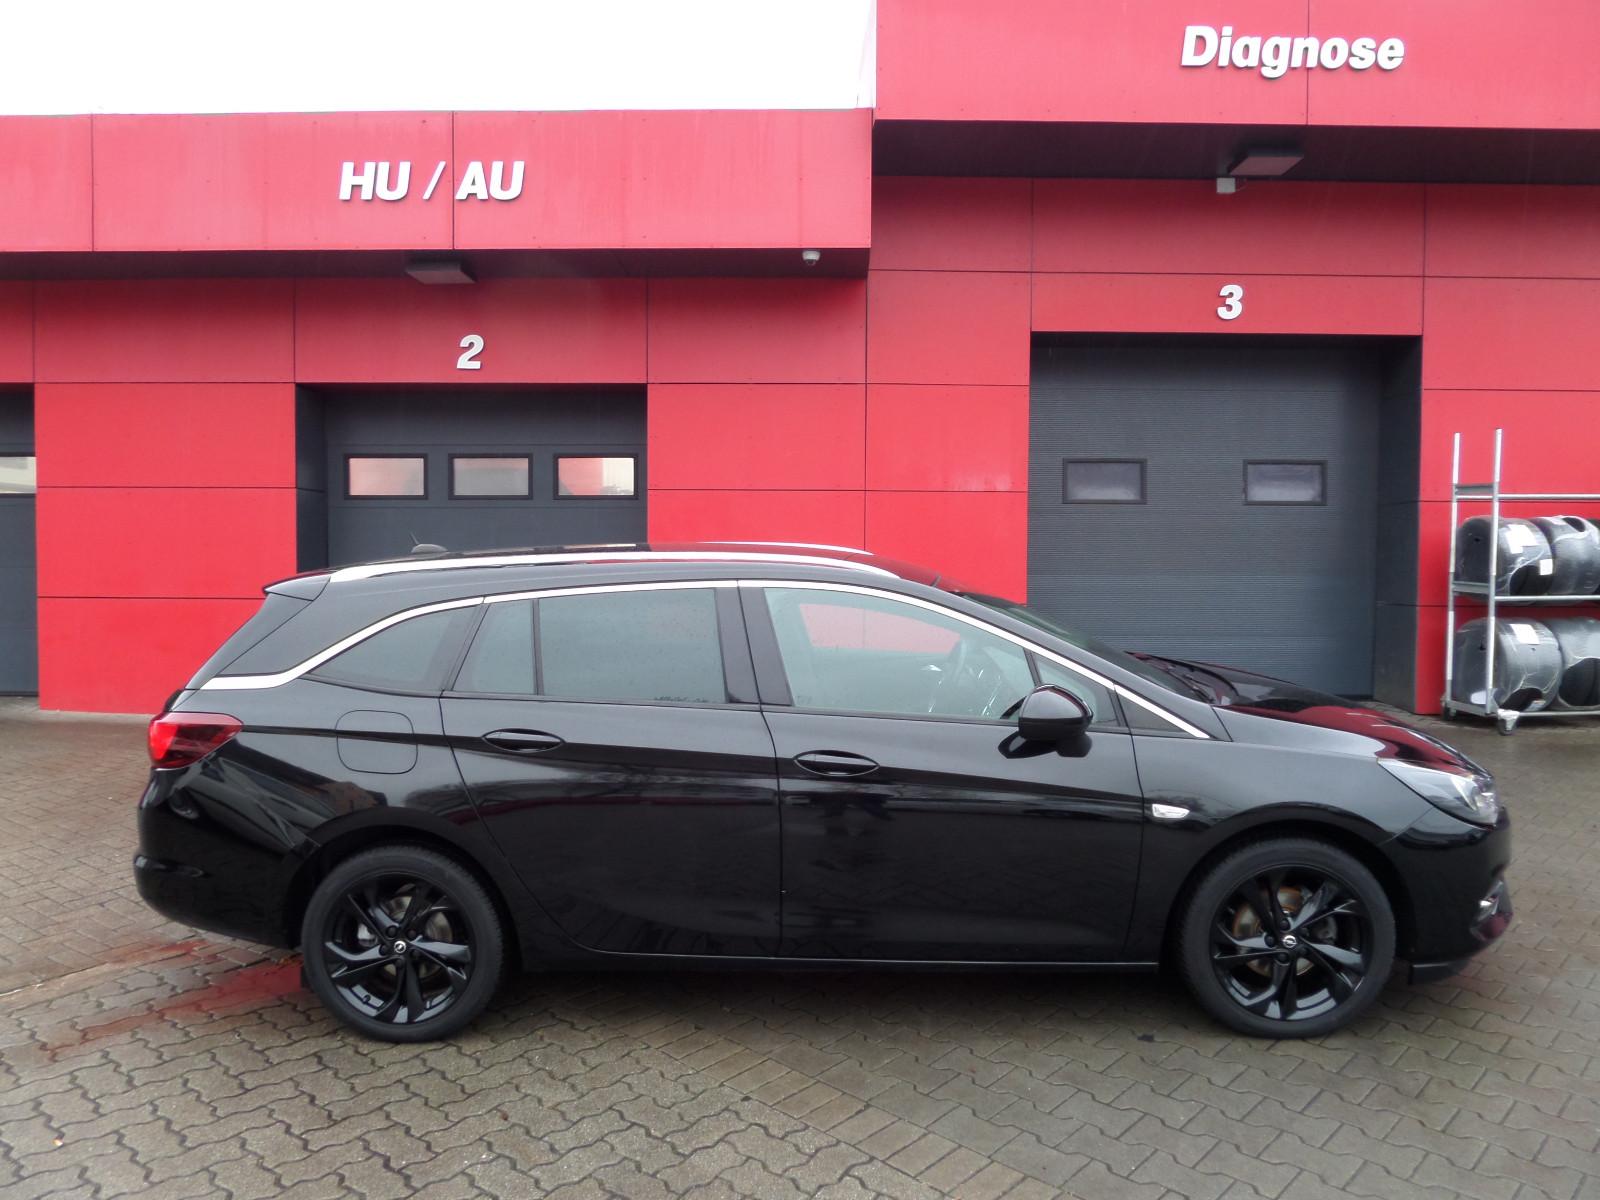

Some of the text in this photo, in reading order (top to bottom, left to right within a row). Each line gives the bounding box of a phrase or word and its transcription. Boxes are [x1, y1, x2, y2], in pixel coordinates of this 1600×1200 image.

[1181, 25, 1406, 79] Diagnose
[338, 160, 526, 201] HU / AU
[1217, 284, 1244, 320] 3
[456, 334, 485, 370] 2
